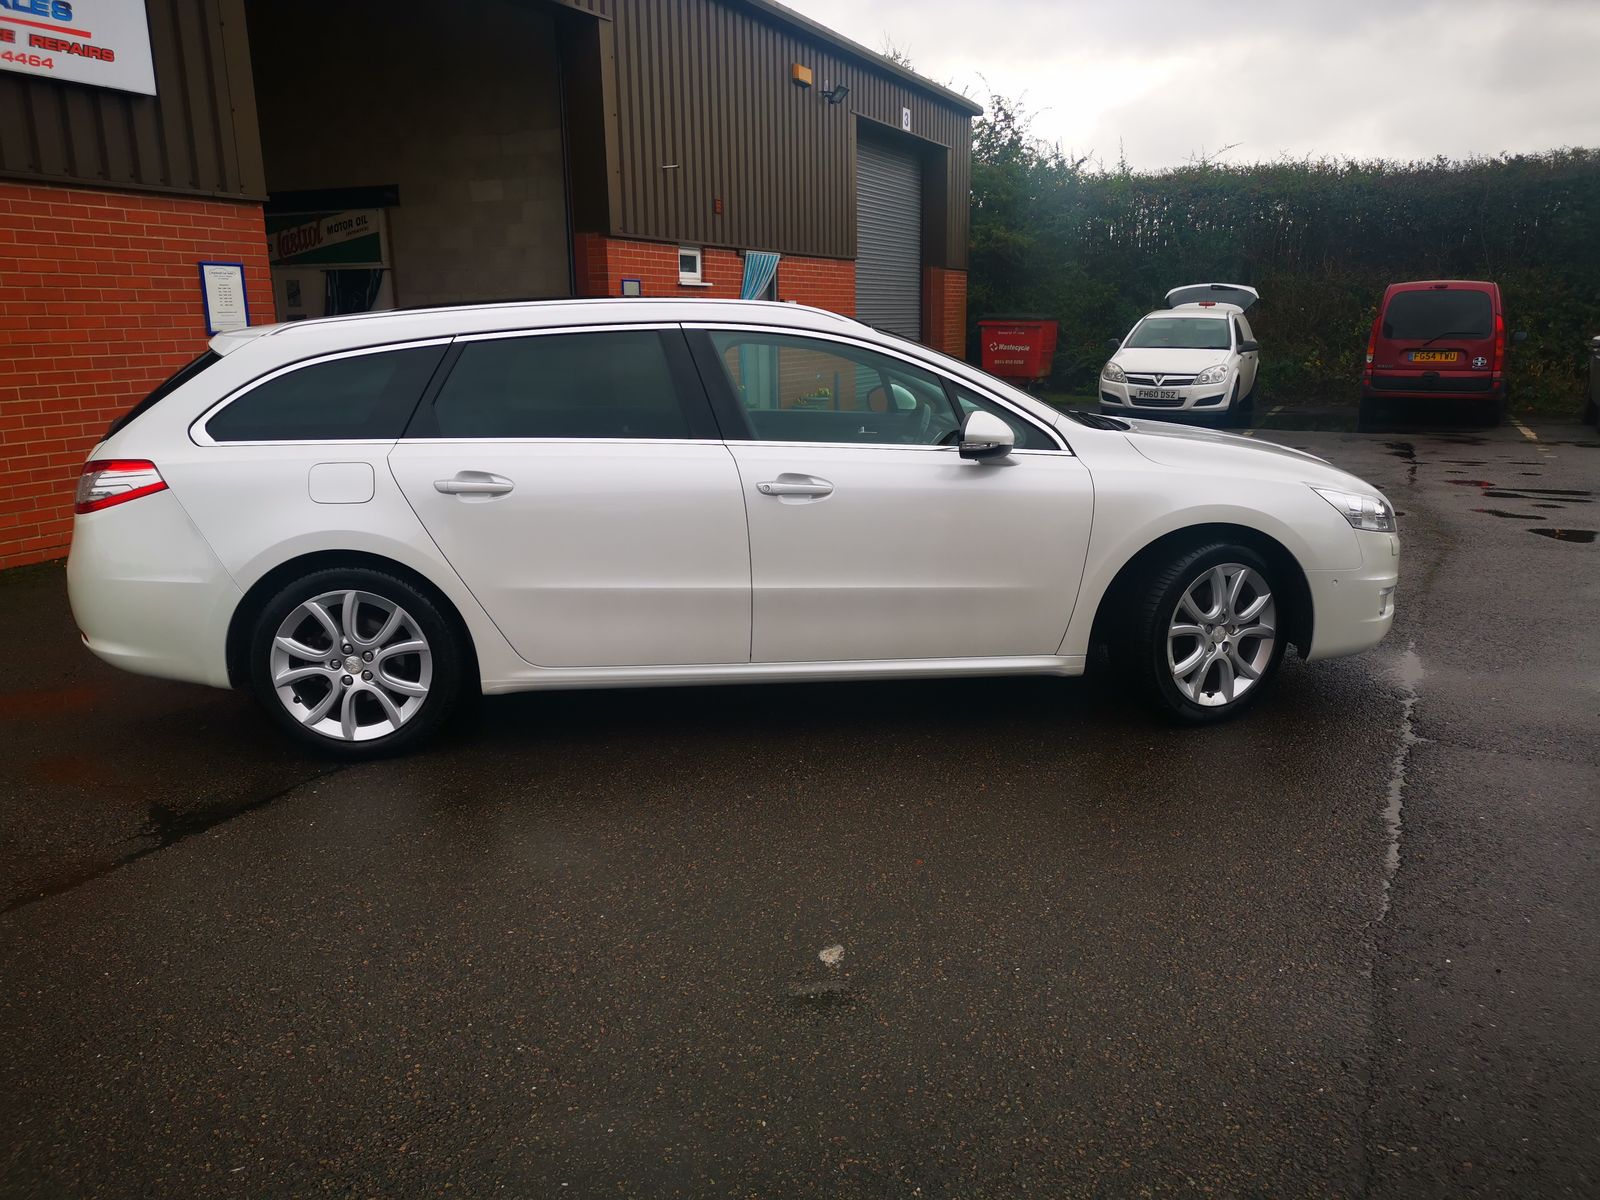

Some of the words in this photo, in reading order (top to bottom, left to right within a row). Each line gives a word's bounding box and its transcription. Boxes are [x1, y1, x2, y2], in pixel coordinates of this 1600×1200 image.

[29, 33, 115, 62] REPAIRS
[1, 50, 54, 69] 4464
[904, 111, 909, 127] 3
[326, 219, 353, 235] MOTOR
[355, 214, 369, 226] OIL
[998, 343, 1030, 352] Wastecycle
[1414, 351, 1436, 360] FG54
[1439, 352, 1456, 361] TWU
[1138, 390, 1159, 398] FH60
[1160, 391, 1176, 399] DSZ
